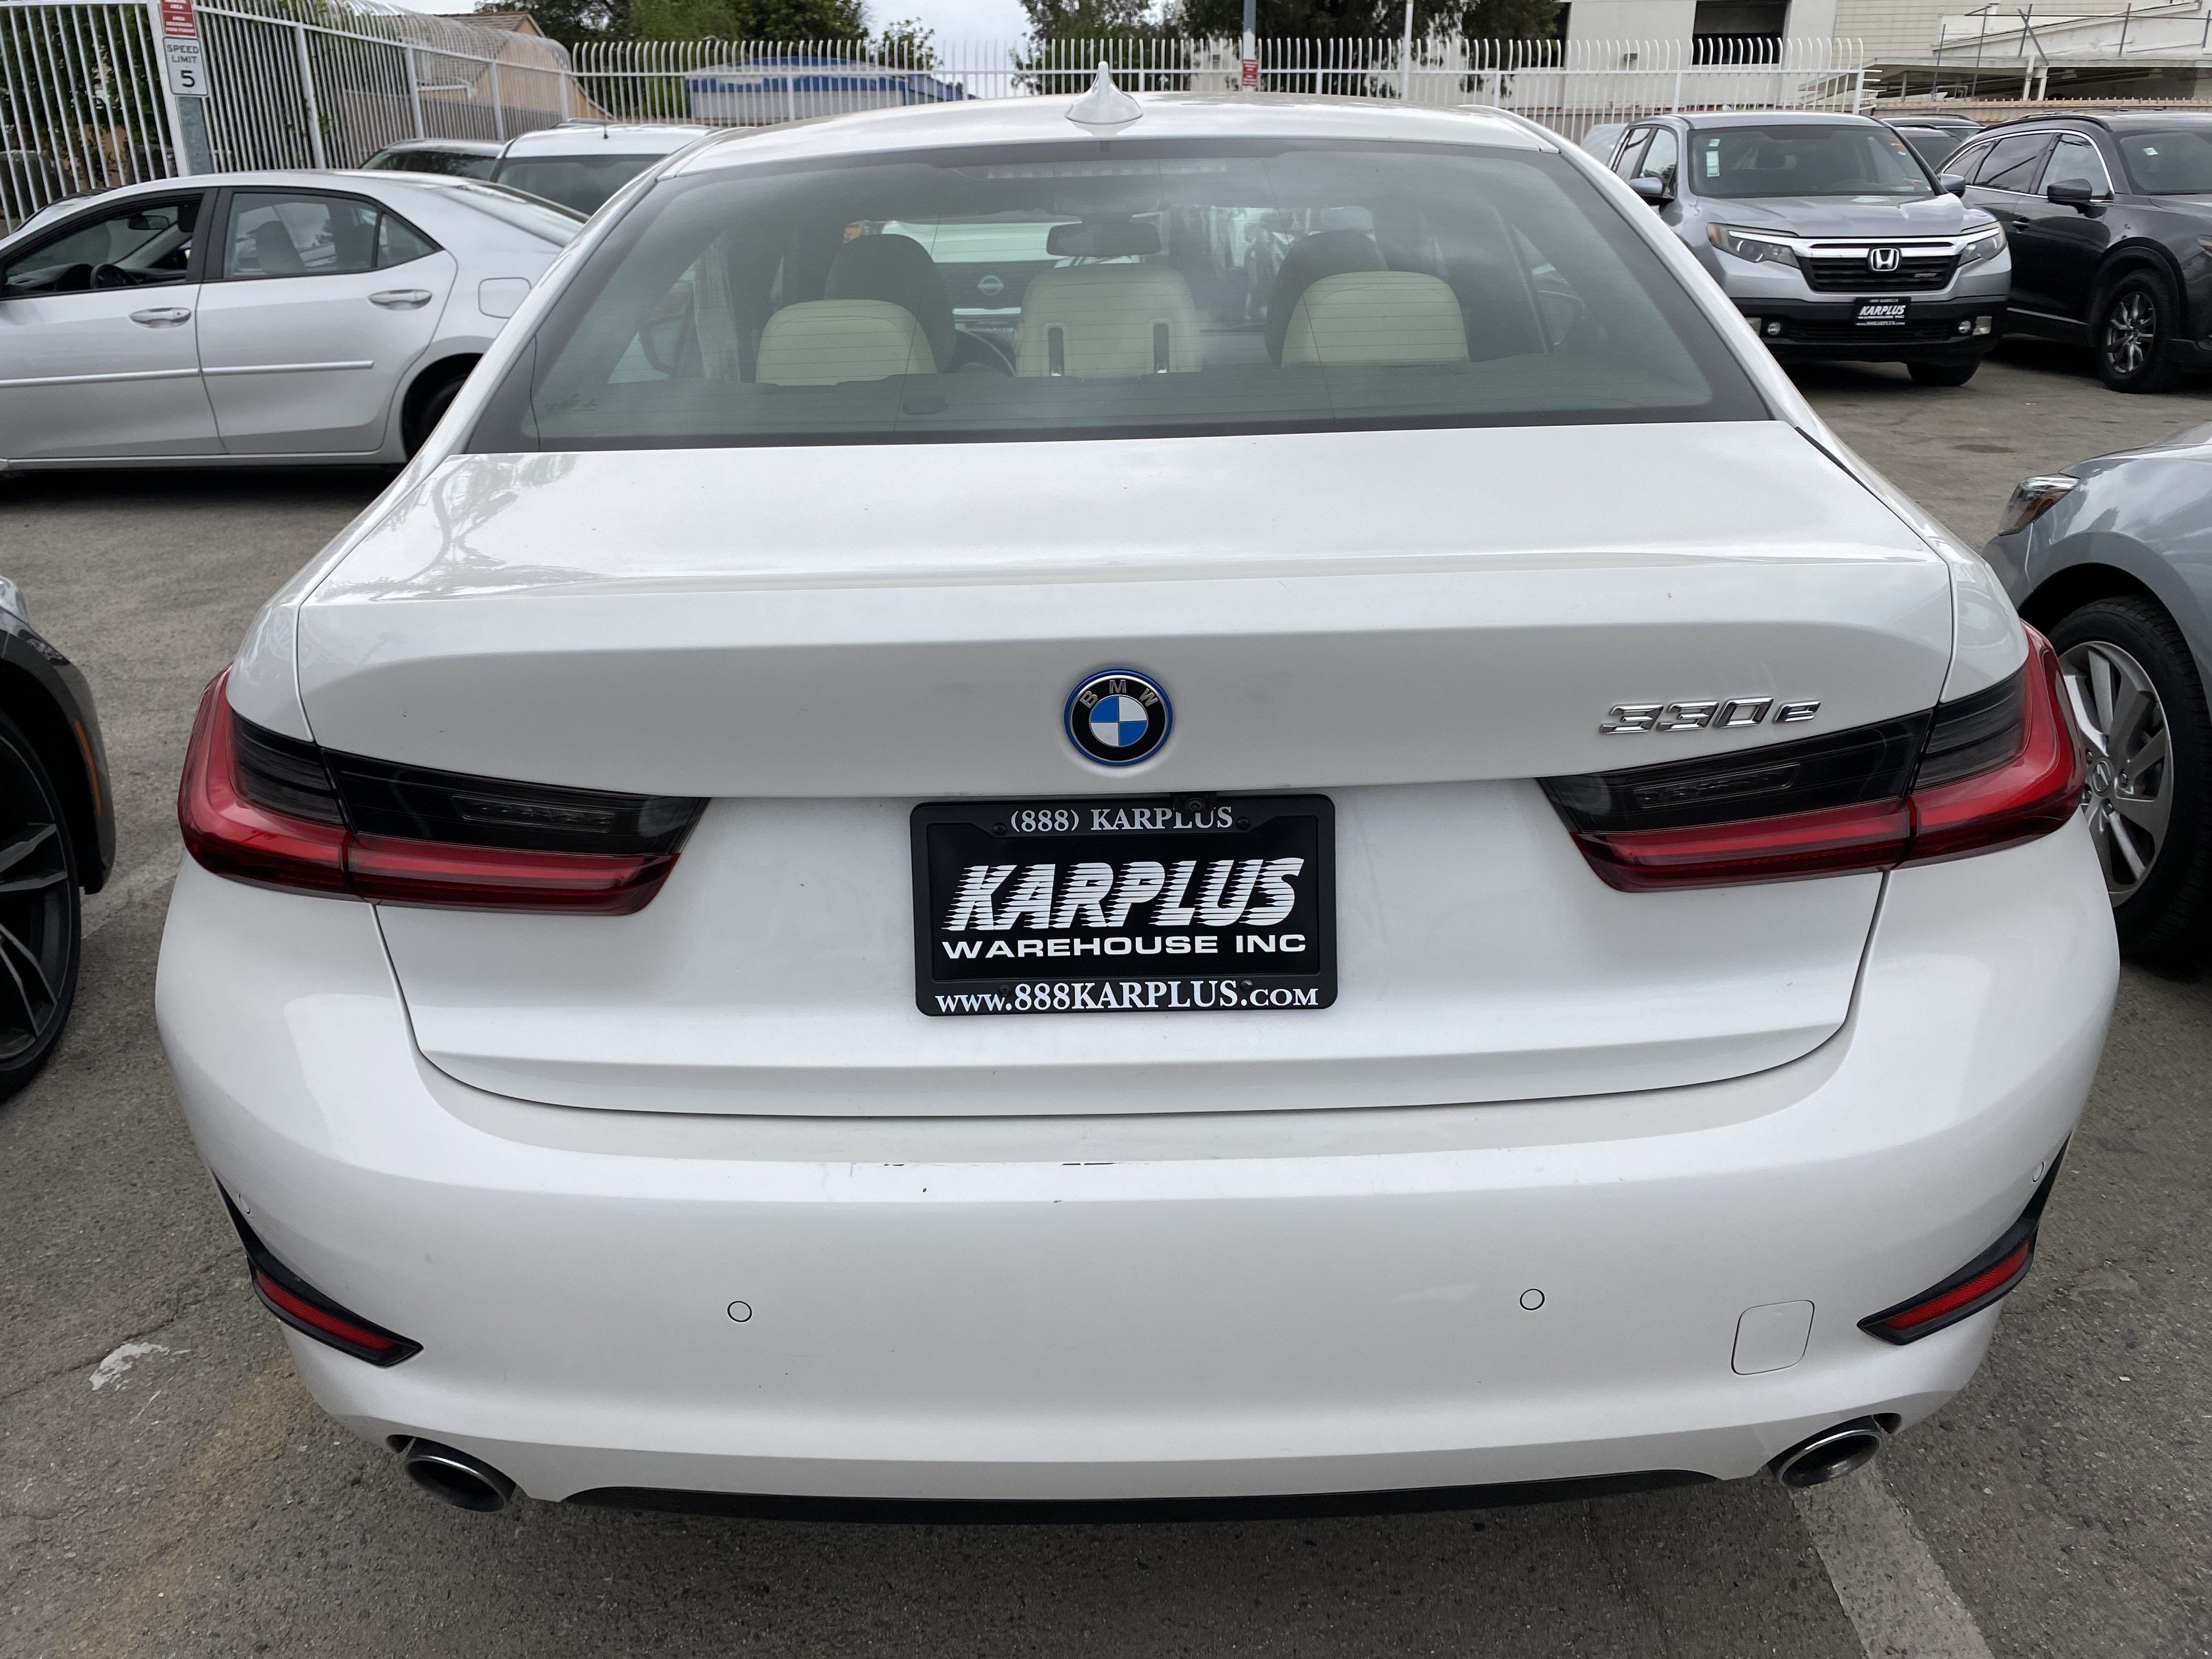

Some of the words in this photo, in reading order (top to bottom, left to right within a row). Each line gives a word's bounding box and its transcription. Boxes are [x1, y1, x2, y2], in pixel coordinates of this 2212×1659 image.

[167, 44, 199, 53] SPEED
[171, 55, 197, 64] LIMIT
[180, 70, 195, 87] 5
[1859, 305, 1906, 315] KARPLUS
[1079, 679, 1159, 709] BMW
[1011, 809, 1079, 832] (888)
[1091, 806, 1233, 831] KARPLUS
[941, 857, 1304, 930] KARPLUS
[941, 935, 1218, 959] WAREHOUSE
[1236, 934, 1306, 953] INC
